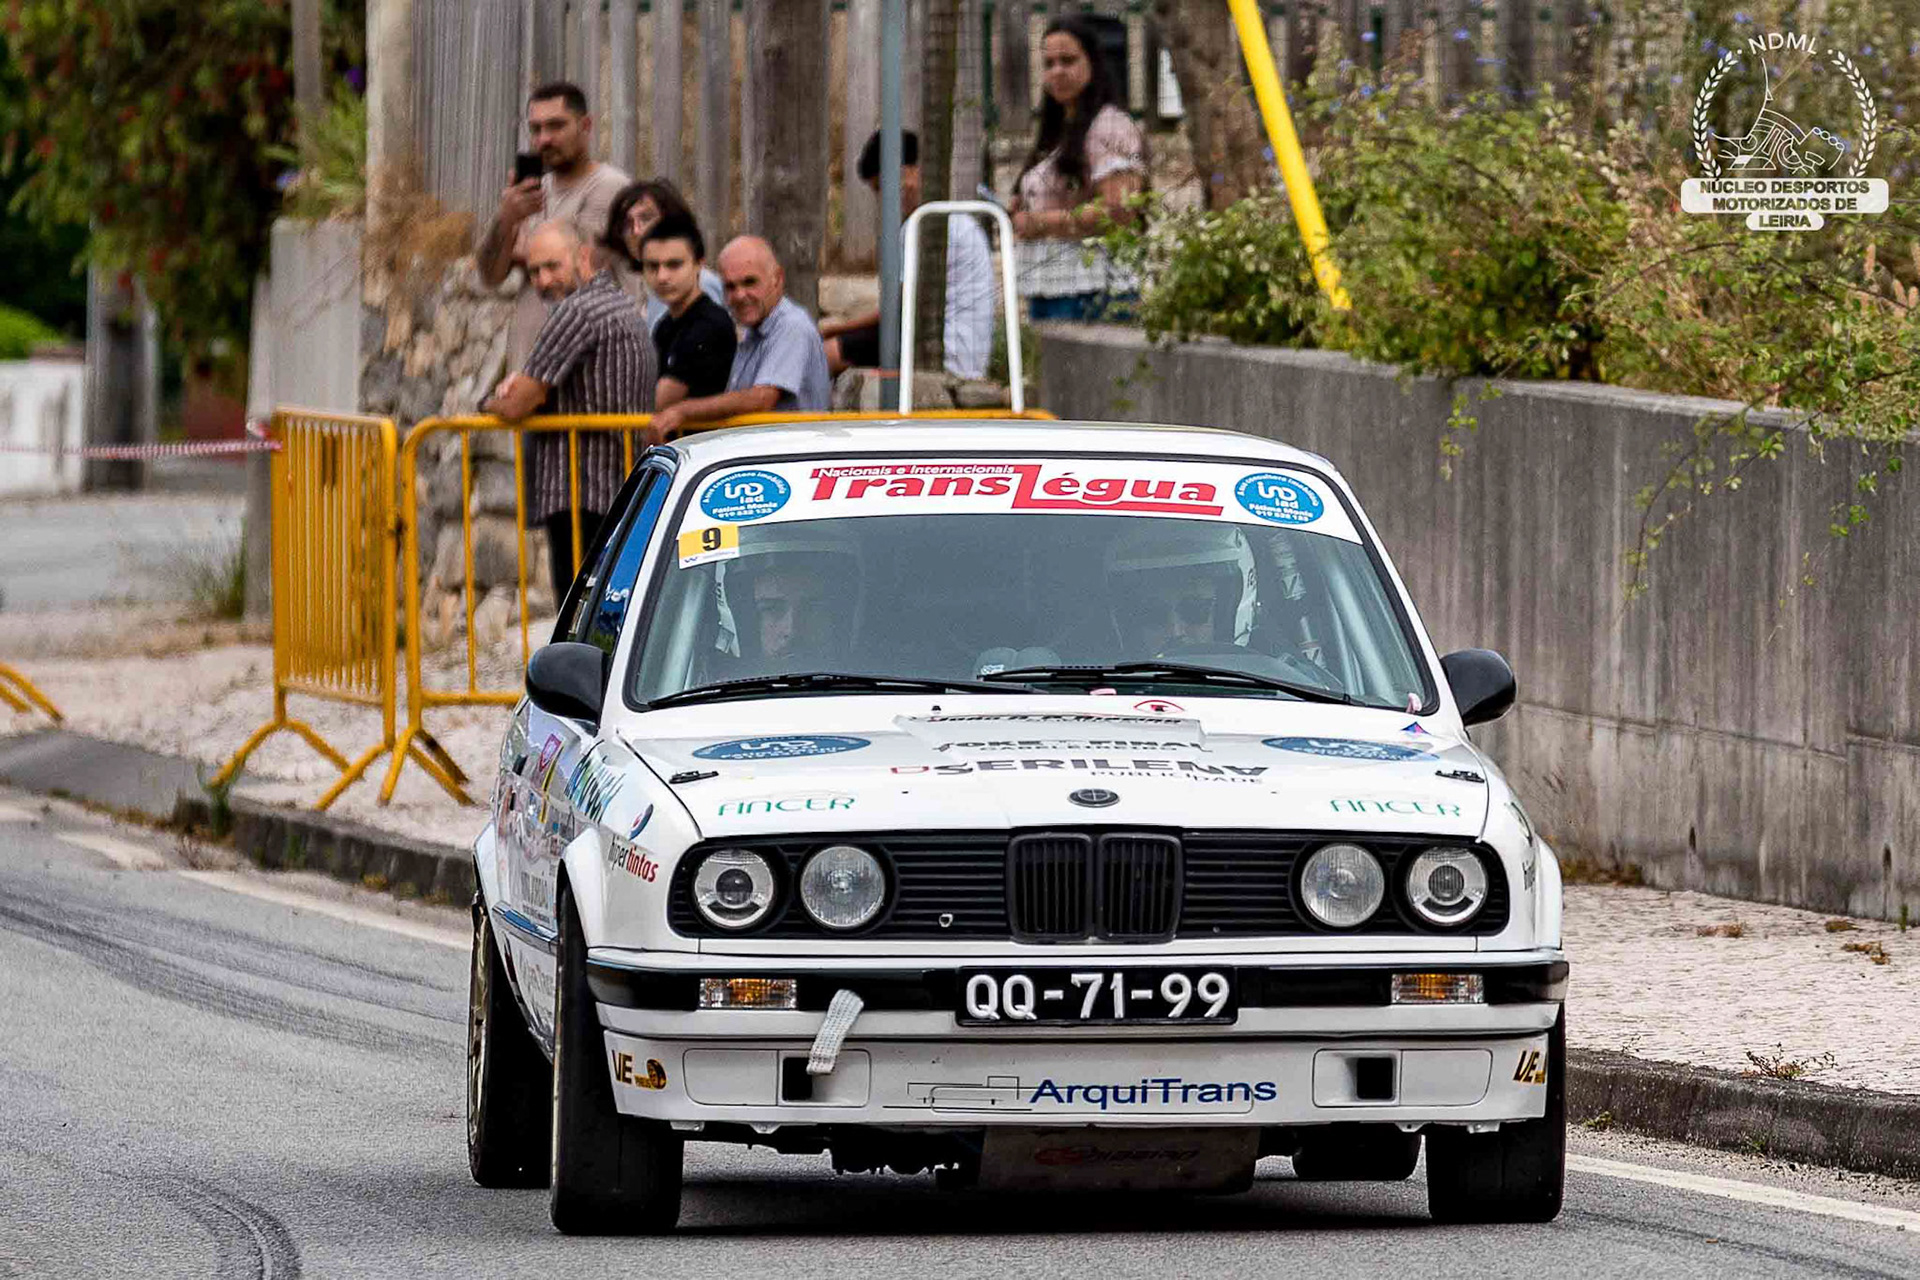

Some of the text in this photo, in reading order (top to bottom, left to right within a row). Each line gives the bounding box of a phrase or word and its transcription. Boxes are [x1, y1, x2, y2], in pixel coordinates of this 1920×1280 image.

[819, 465, 1015, 478] Nacionais e Internacionais
[702, 527, 721, 551] 9
[966, 972, 1230, 1020] QQ-71-99
[1030, 1078, 1277, 1110] ArquiTrans
